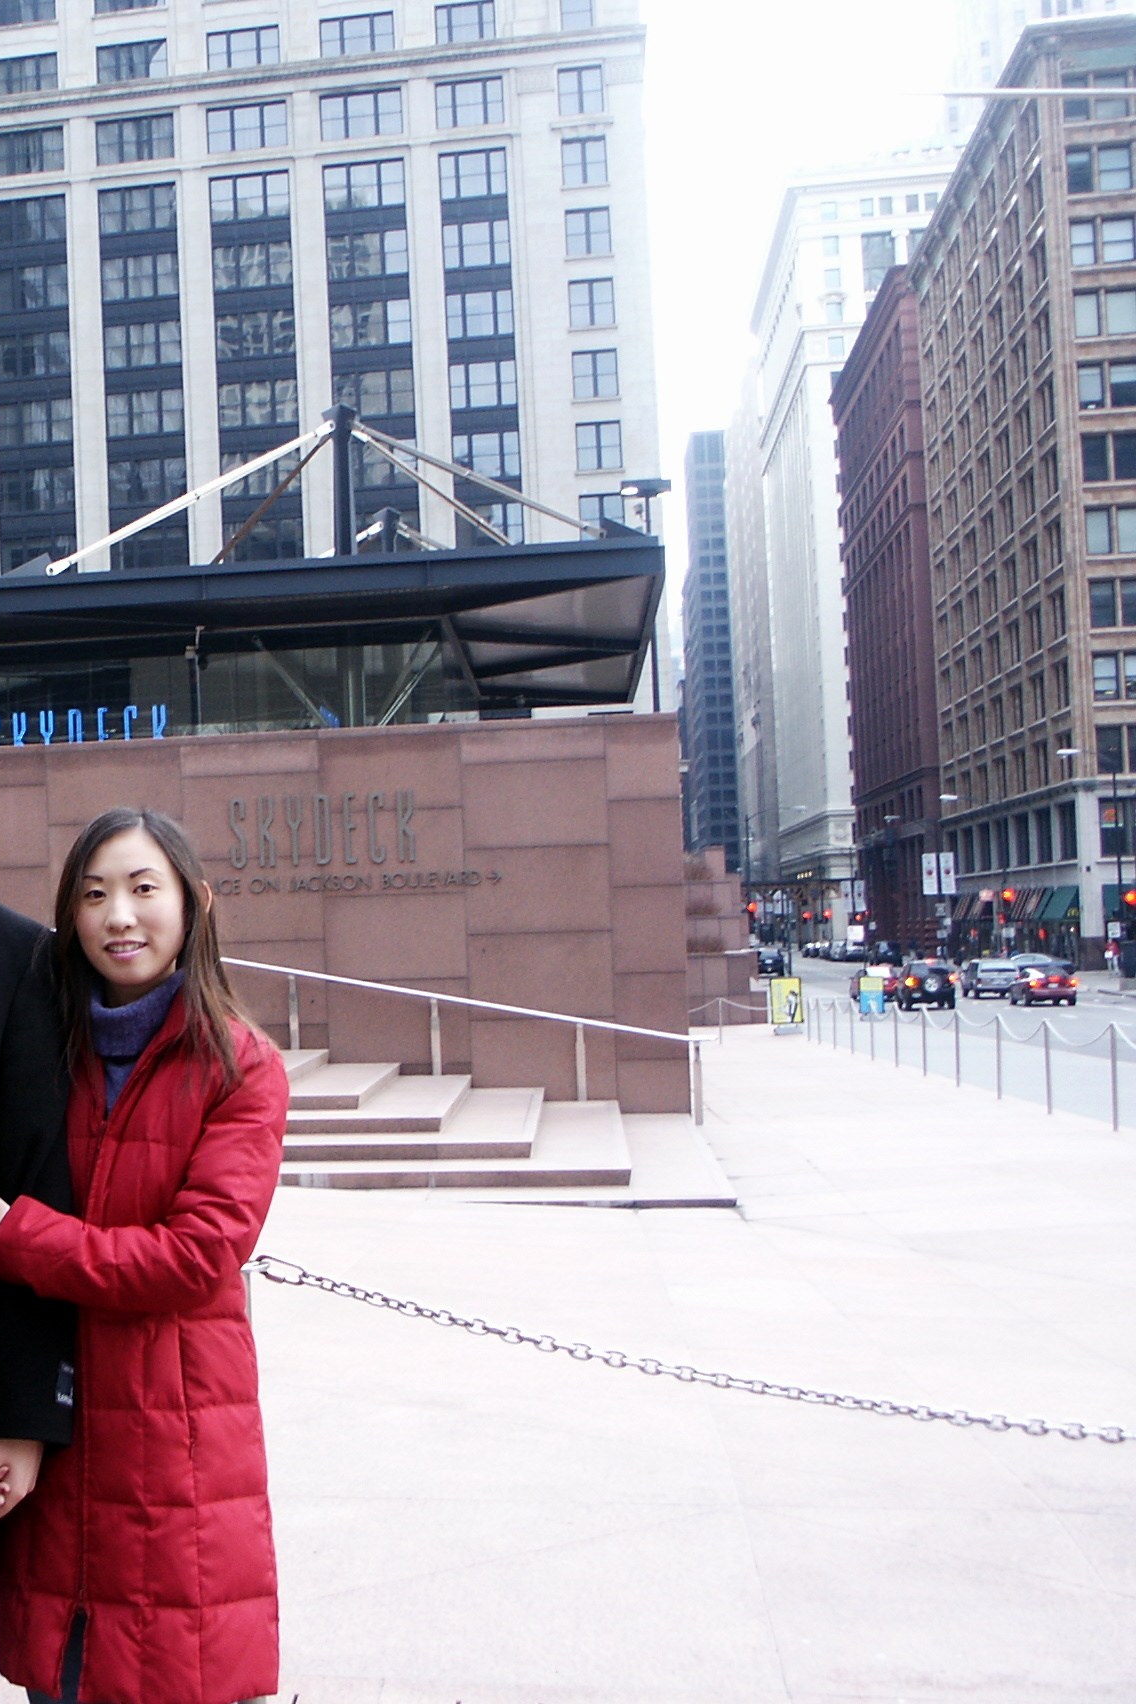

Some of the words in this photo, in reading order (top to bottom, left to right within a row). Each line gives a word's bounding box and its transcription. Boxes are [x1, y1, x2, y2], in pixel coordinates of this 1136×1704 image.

[229, 789, 415, 869] SKYDECK
[250, 876, 281, 895] ON
[288, 872, 372, 894] JACKSON
[382, 870, 482, 890] BOULEARD
